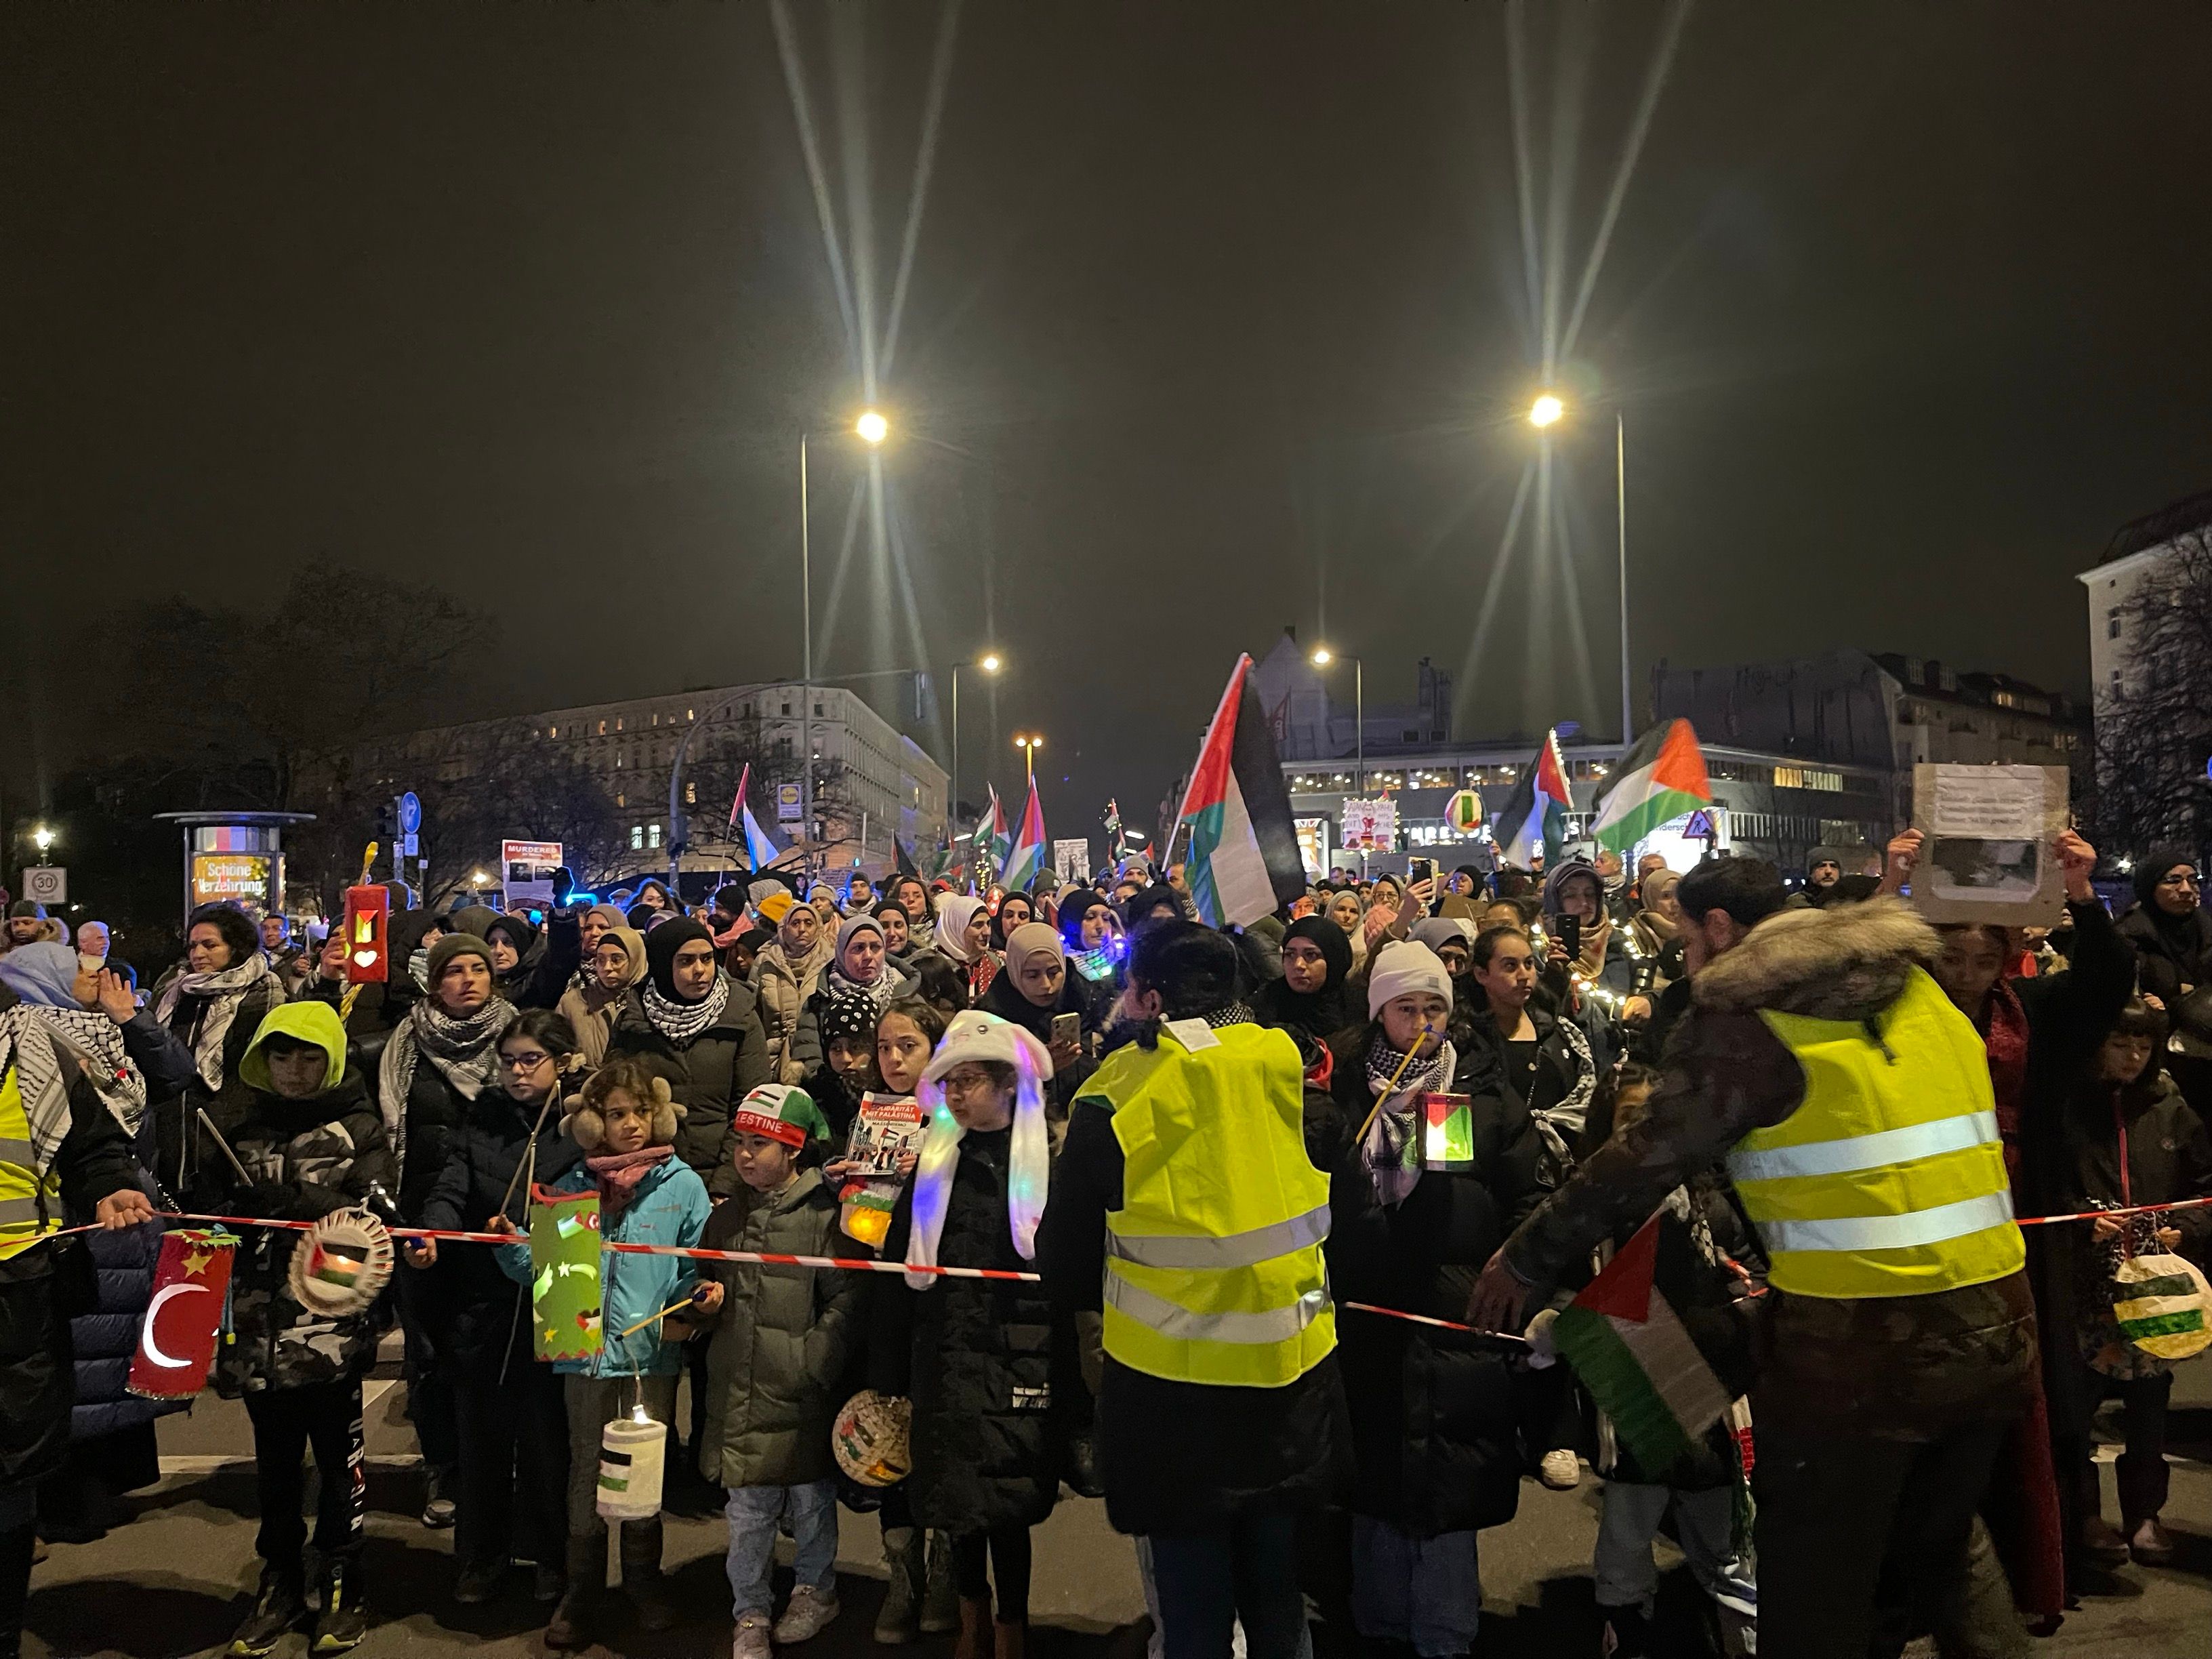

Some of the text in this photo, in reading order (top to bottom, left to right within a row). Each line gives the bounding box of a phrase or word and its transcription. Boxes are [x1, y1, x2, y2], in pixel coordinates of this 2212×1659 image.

[508, 845, 557, 853] MURDERED
[208, 863, 251, 876] Schöne
[38, 877, 53, 888] 30
[199, 878, 263, 896] Verzehrung
[878, 1111, 916, 1120] PALÄSTINA
